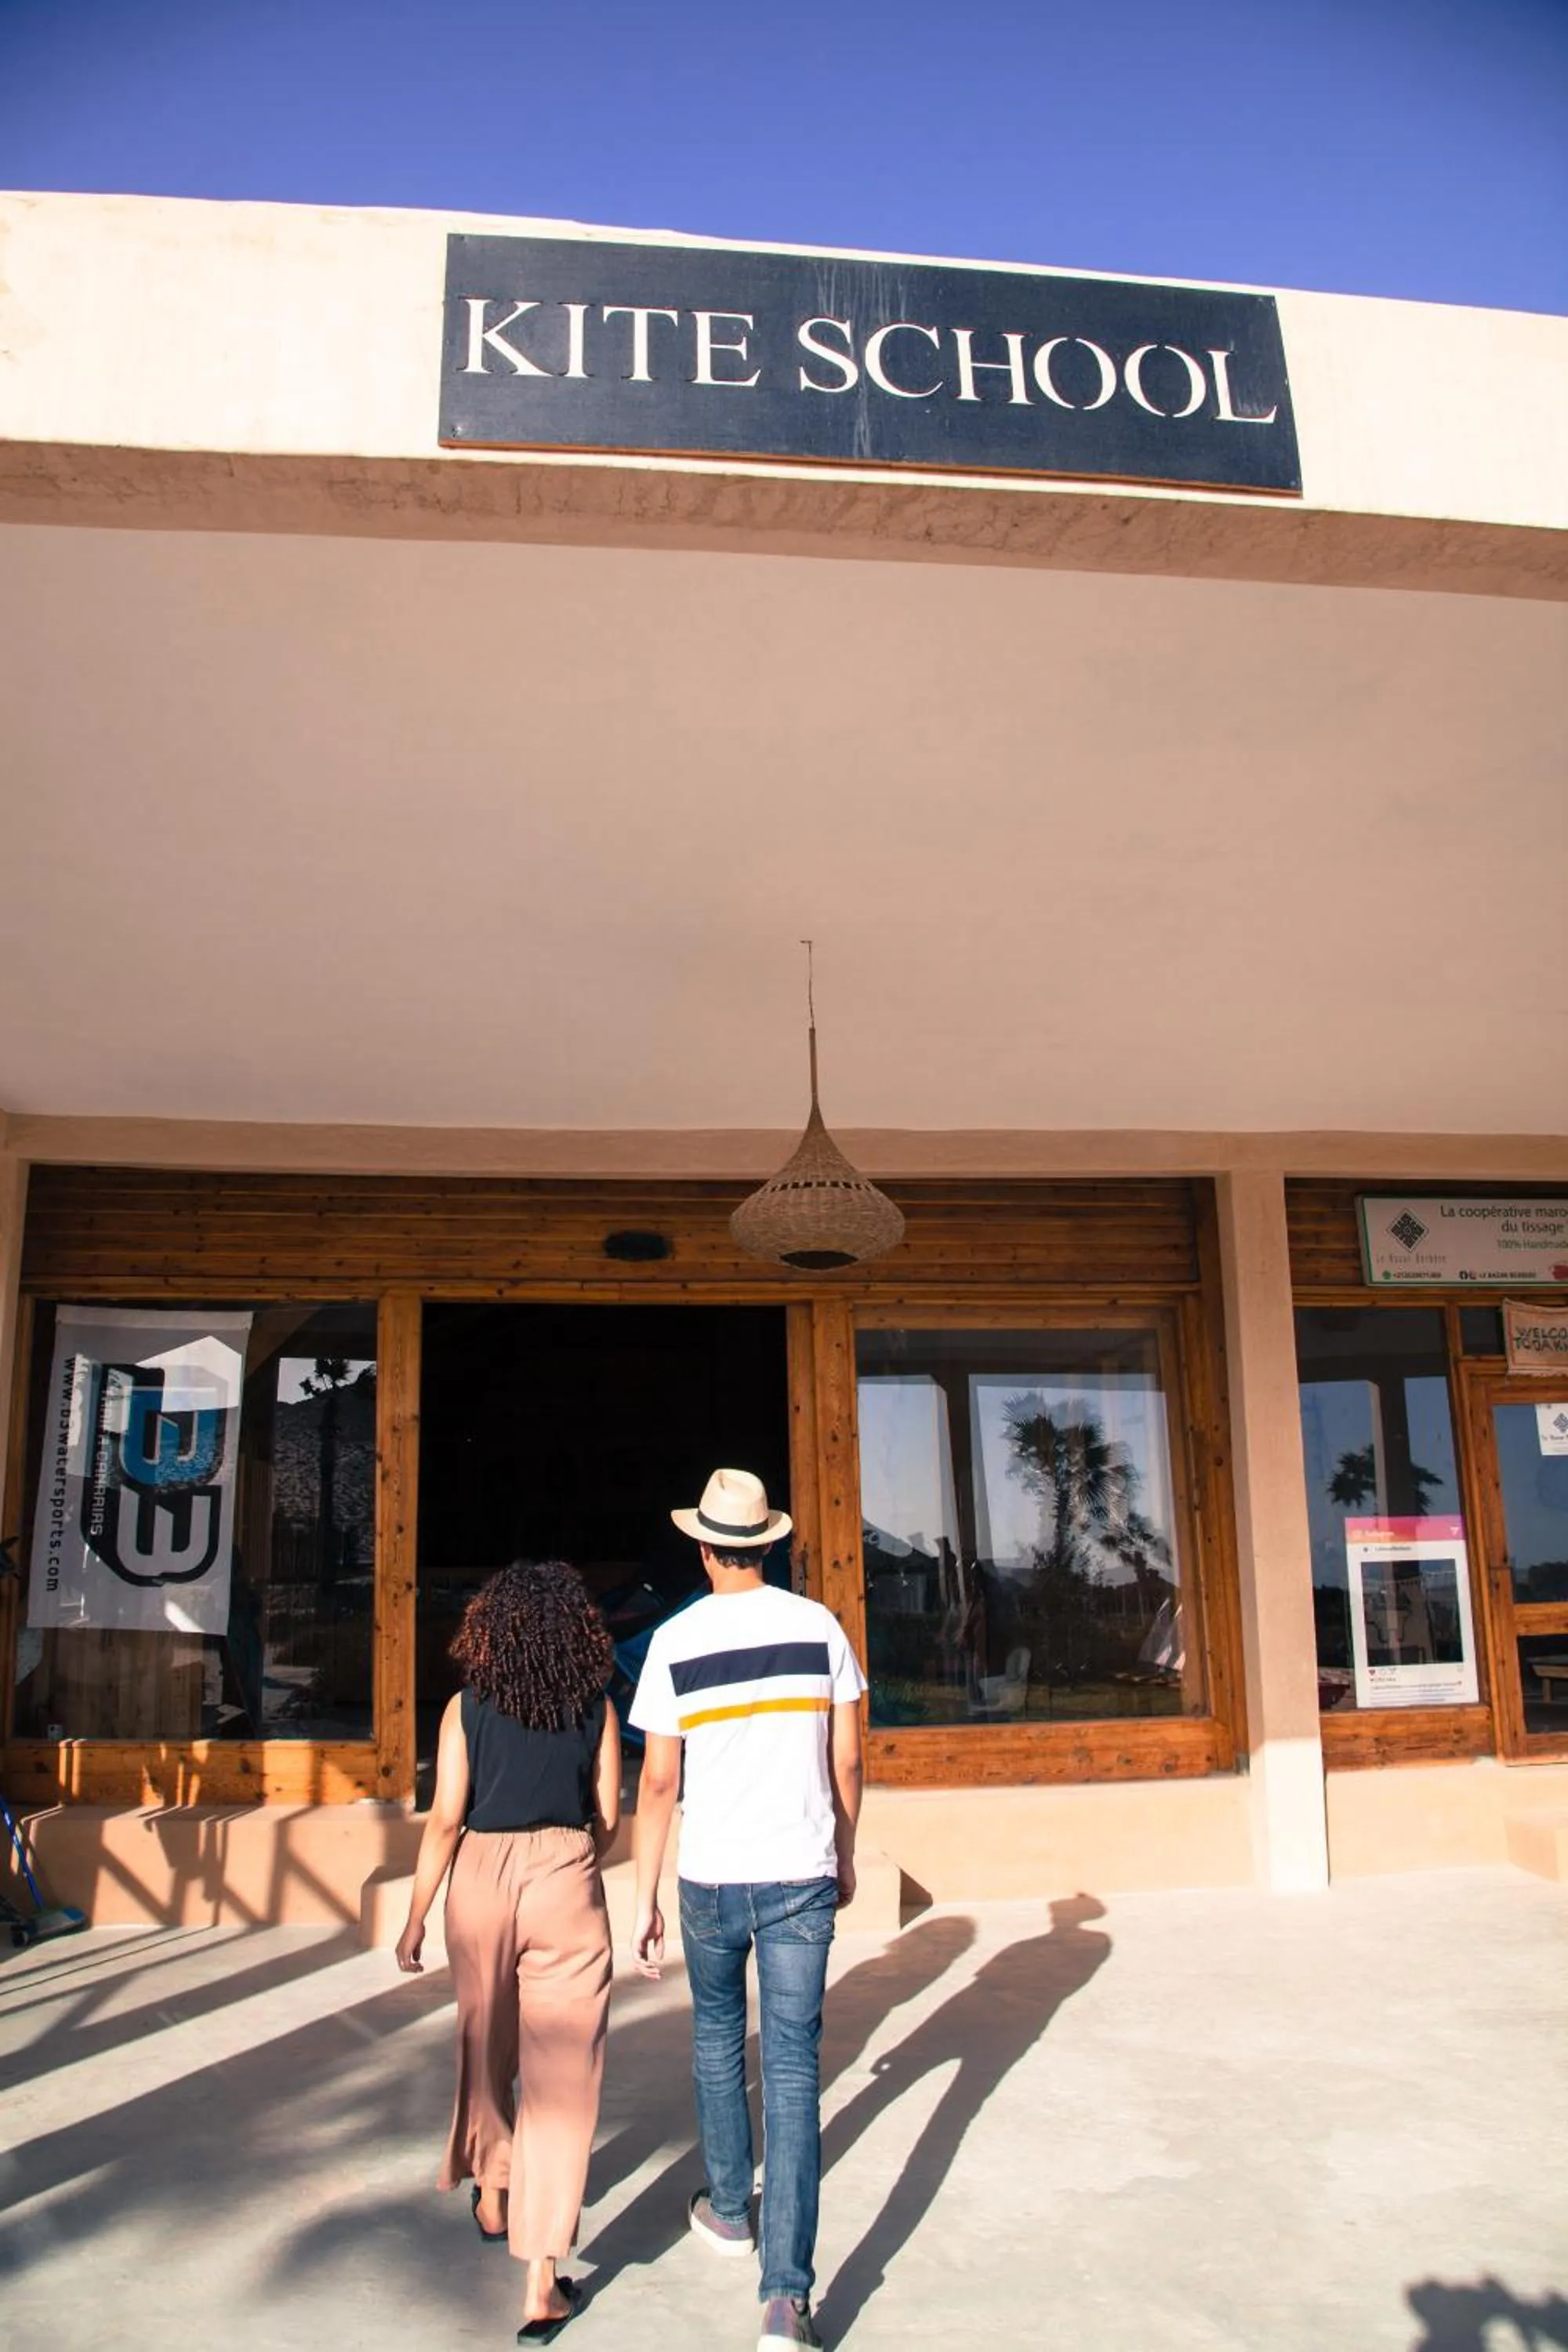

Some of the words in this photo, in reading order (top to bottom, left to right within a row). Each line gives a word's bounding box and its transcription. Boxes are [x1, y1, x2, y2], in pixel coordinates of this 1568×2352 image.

[463, 297, 761, 387] KITE
[798, 317, 1278, 424] SCHOOL
[1440, 1205, 1454, 1218] La
[1458, 1205, 1531, 1220] coopérative
[1536, 1207, 1568, 1218] maro
[1501, 1220, 1518, 1232] du
[1522, 1221, 1564, 1236] tissage
[45, 1356, 77, 1592] www.b3watersports.com
[89, 1450, 109, 1536] CANARIAS
